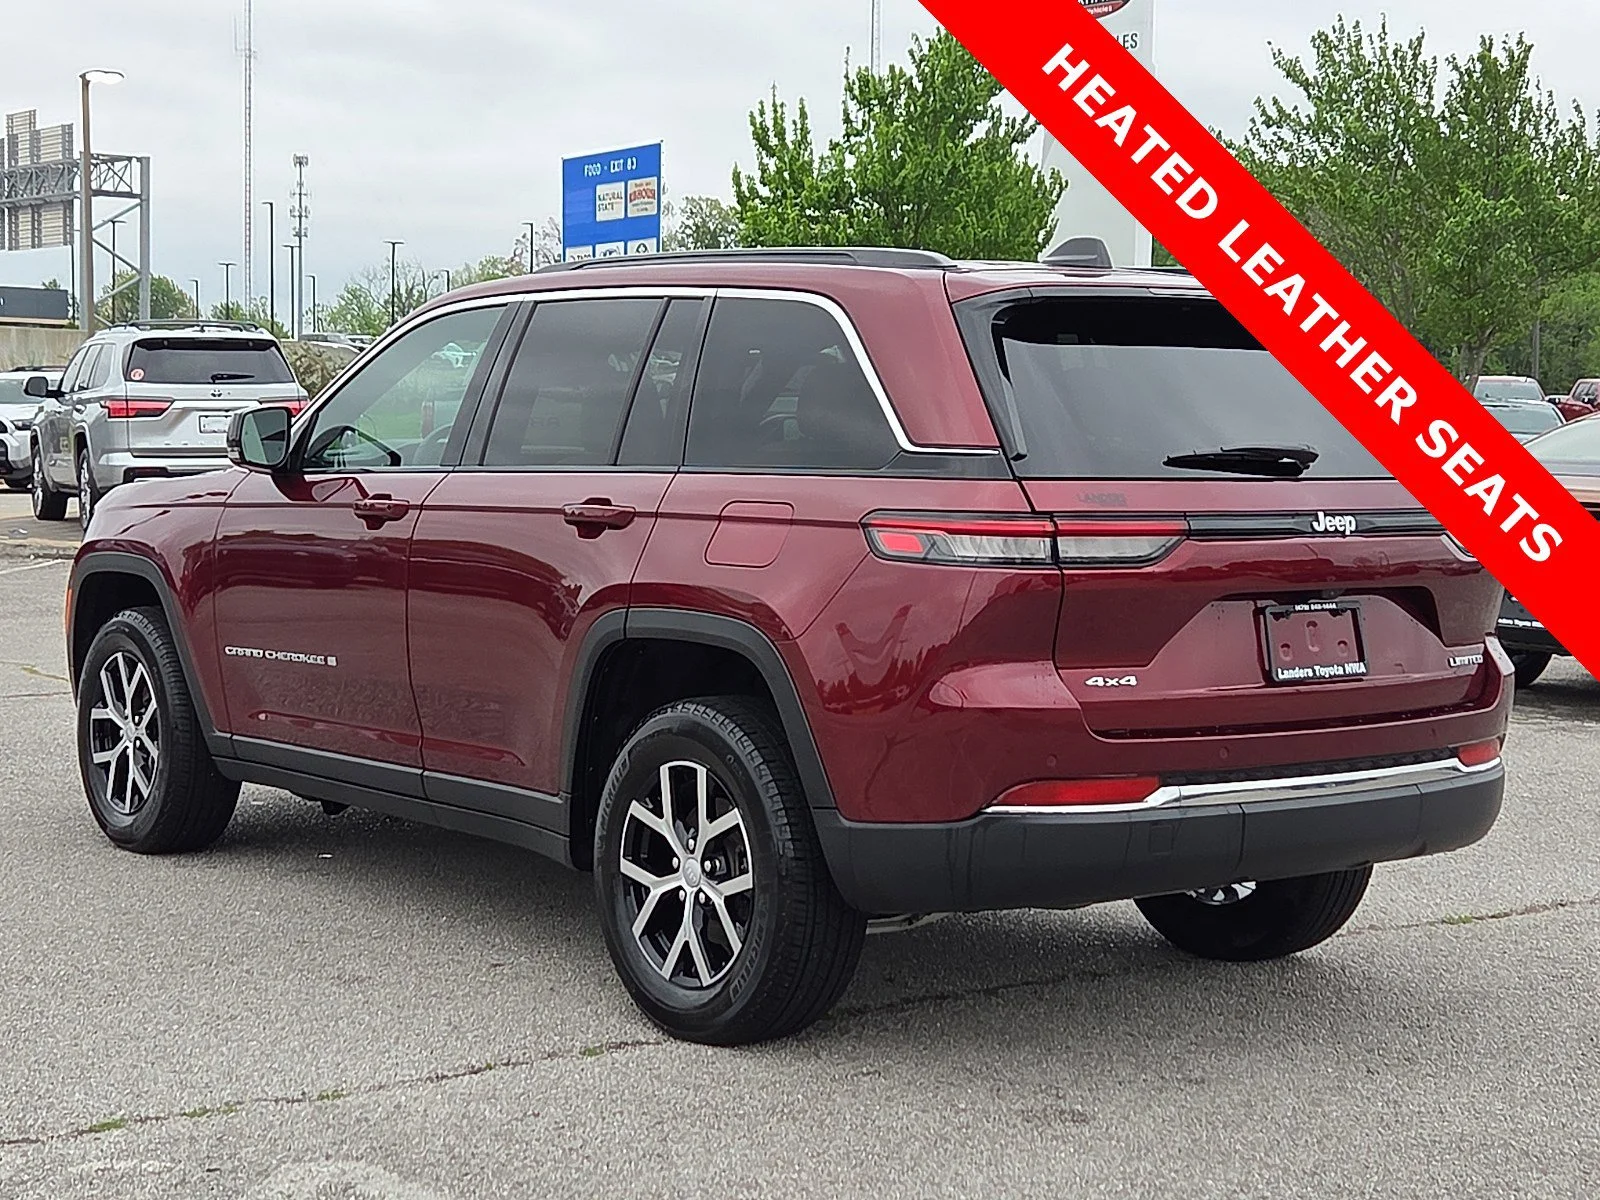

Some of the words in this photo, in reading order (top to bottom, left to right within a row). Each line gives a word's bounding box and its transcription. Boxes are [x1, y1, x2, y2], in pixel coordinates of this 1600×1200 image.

[584, 162, 602, 177] FOOD
[610, 159, 624, 173] EXIT
[597, 190, 623, 203] NATURAL
[597, 203, 615, 212] STATE
[1312, 511, 1356, 535] Jeep
[225, 646, 264, 658] GRAND
[265, 650, 326, 665] CHEROKEE
[1277, 666, 1313, 679] Landers
[1314, 664, 1345, 679] Toyota
[1344, 662, 1366, 675] NWA
[1085, 675, 1138, 687] 4x4
